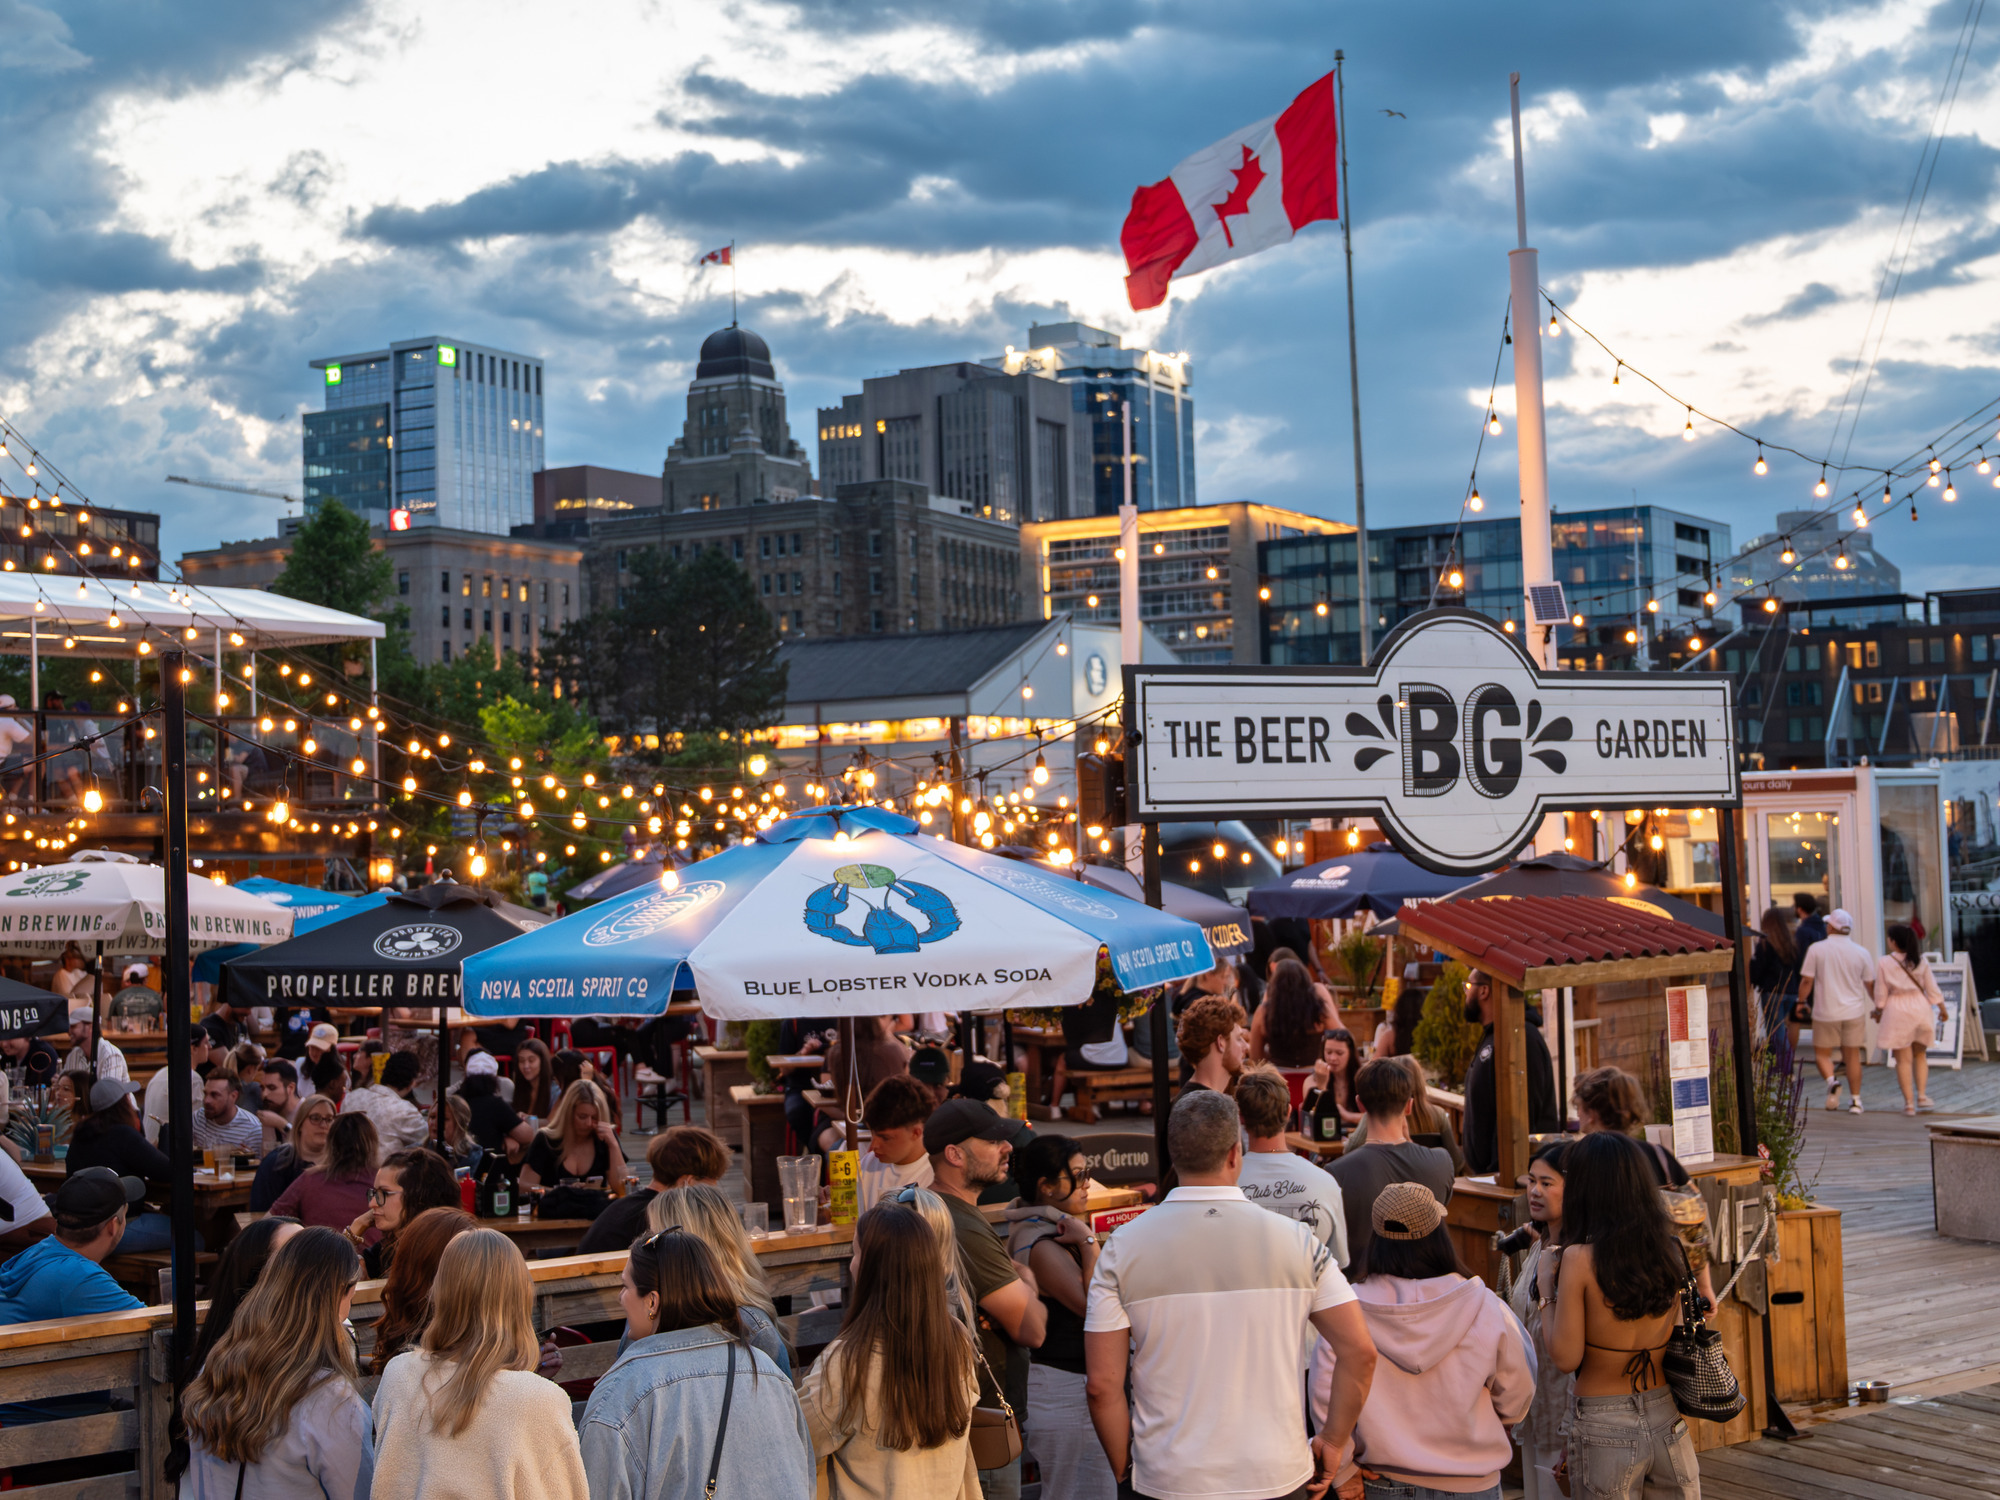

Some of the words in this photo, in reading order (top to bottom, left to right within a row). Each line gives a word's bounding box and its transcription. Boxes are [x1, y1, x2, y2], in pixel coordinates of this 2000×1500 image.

[438, 346, 455, 364] TD
[326, 367, 340, 382] TD
[1164, 720, 1222, 758] THE
[1234, 716, 1332, 764] BEER
[1596, 718, 1708, 759] GARDEN
[1399, 682, 1523, 799] BG
[1767, 778, 1792, 792] daily
[19, 914, 104, 932] BREWING
[104, 921, 120, 932] CO.
[144, 912, 199, 932] BRN
[205, 916, 272, 936] BREWING
[1211, 922, 1249, 948] CIDER
[1155, 941, 1180, 963] SPIRIT
[1181, 940, 1195, 958] CO
[267, 974, 394, 998] PROPELLER
[480, 980, 521, 1000] NOVA
[528, 977, 574, 998] SCOTIA
[581, 977, 624, 998] SPIRIT
[627, 977, 648, 998] CO
[744, 980, 802, 996] BLUE
[808, 975, 907, 994] LOBSTER
[912, 971, 988, 988] VODKA
[994, 967, 1053, 984] SODA
[24, 1007, 39, 1020] CO
[844, 1161, 851, 1176] 6
[1103, 1148, 1149, 1171] Cuervo
[1273, 1179, 1307, 1199] Bleu
[1106, 1216, 1115, 1225] 24
